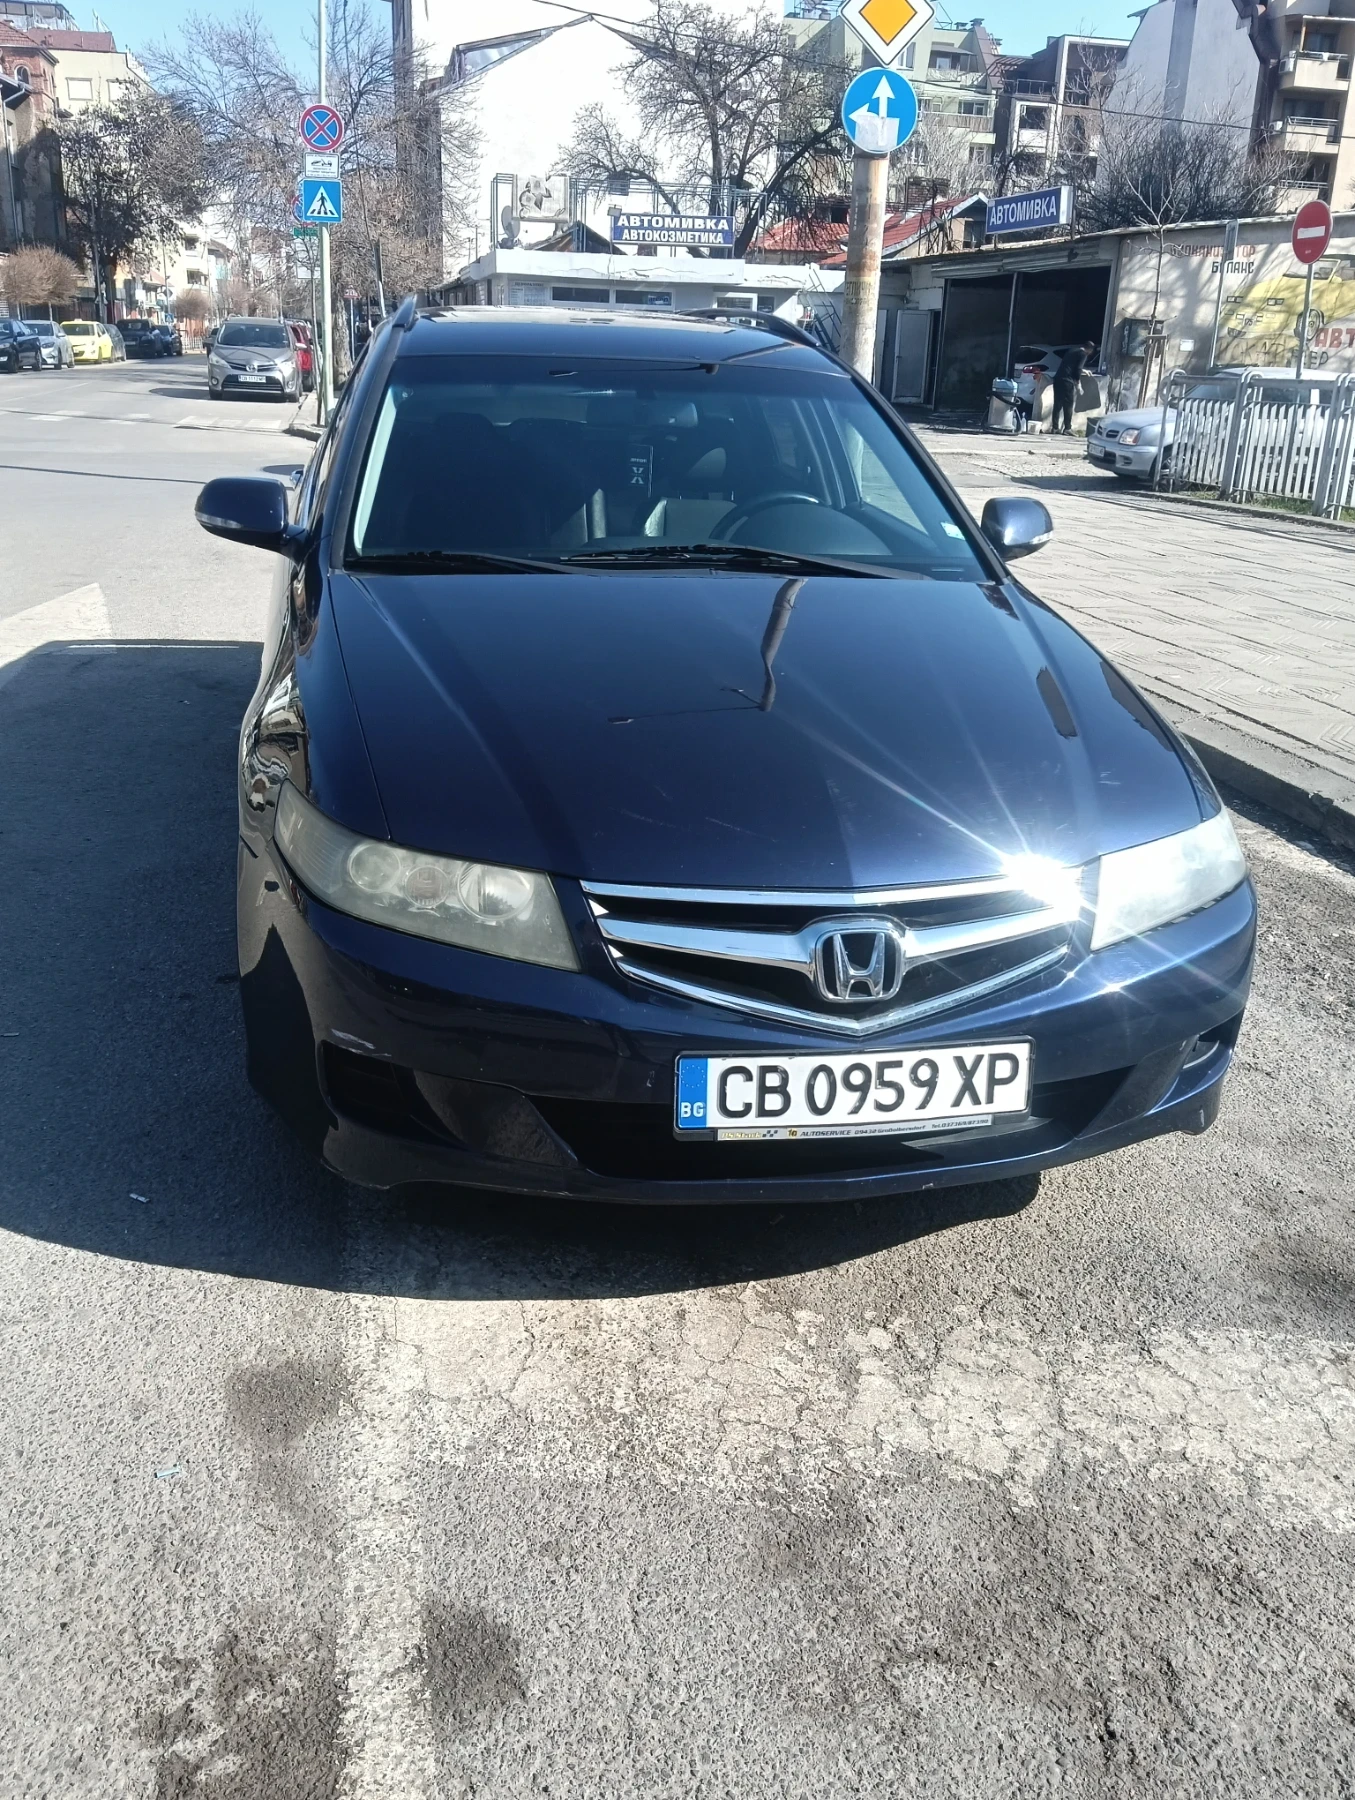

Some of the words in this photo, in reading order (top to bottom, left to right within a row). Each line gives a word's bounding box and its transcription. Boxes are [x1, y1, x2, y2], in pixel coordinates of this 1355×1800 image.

[990, 195, 1057, 226] АВТОМИВКА
[617, 215, 729, 230] АВТОМИВКА
[622, 229, 724, 244] АВТОКОЗМЕТИКА
[1211, 261, 1255, 274] БЛАНС
[716, 1064, 792, 1119] CB
[804, 1057, 940, 1117] 0959
[950, 1052, 1020, 1108] XP
[680, 1102, 705, 1118] BG
[800, 1129, 852, 1138] AUTOSERVICE
